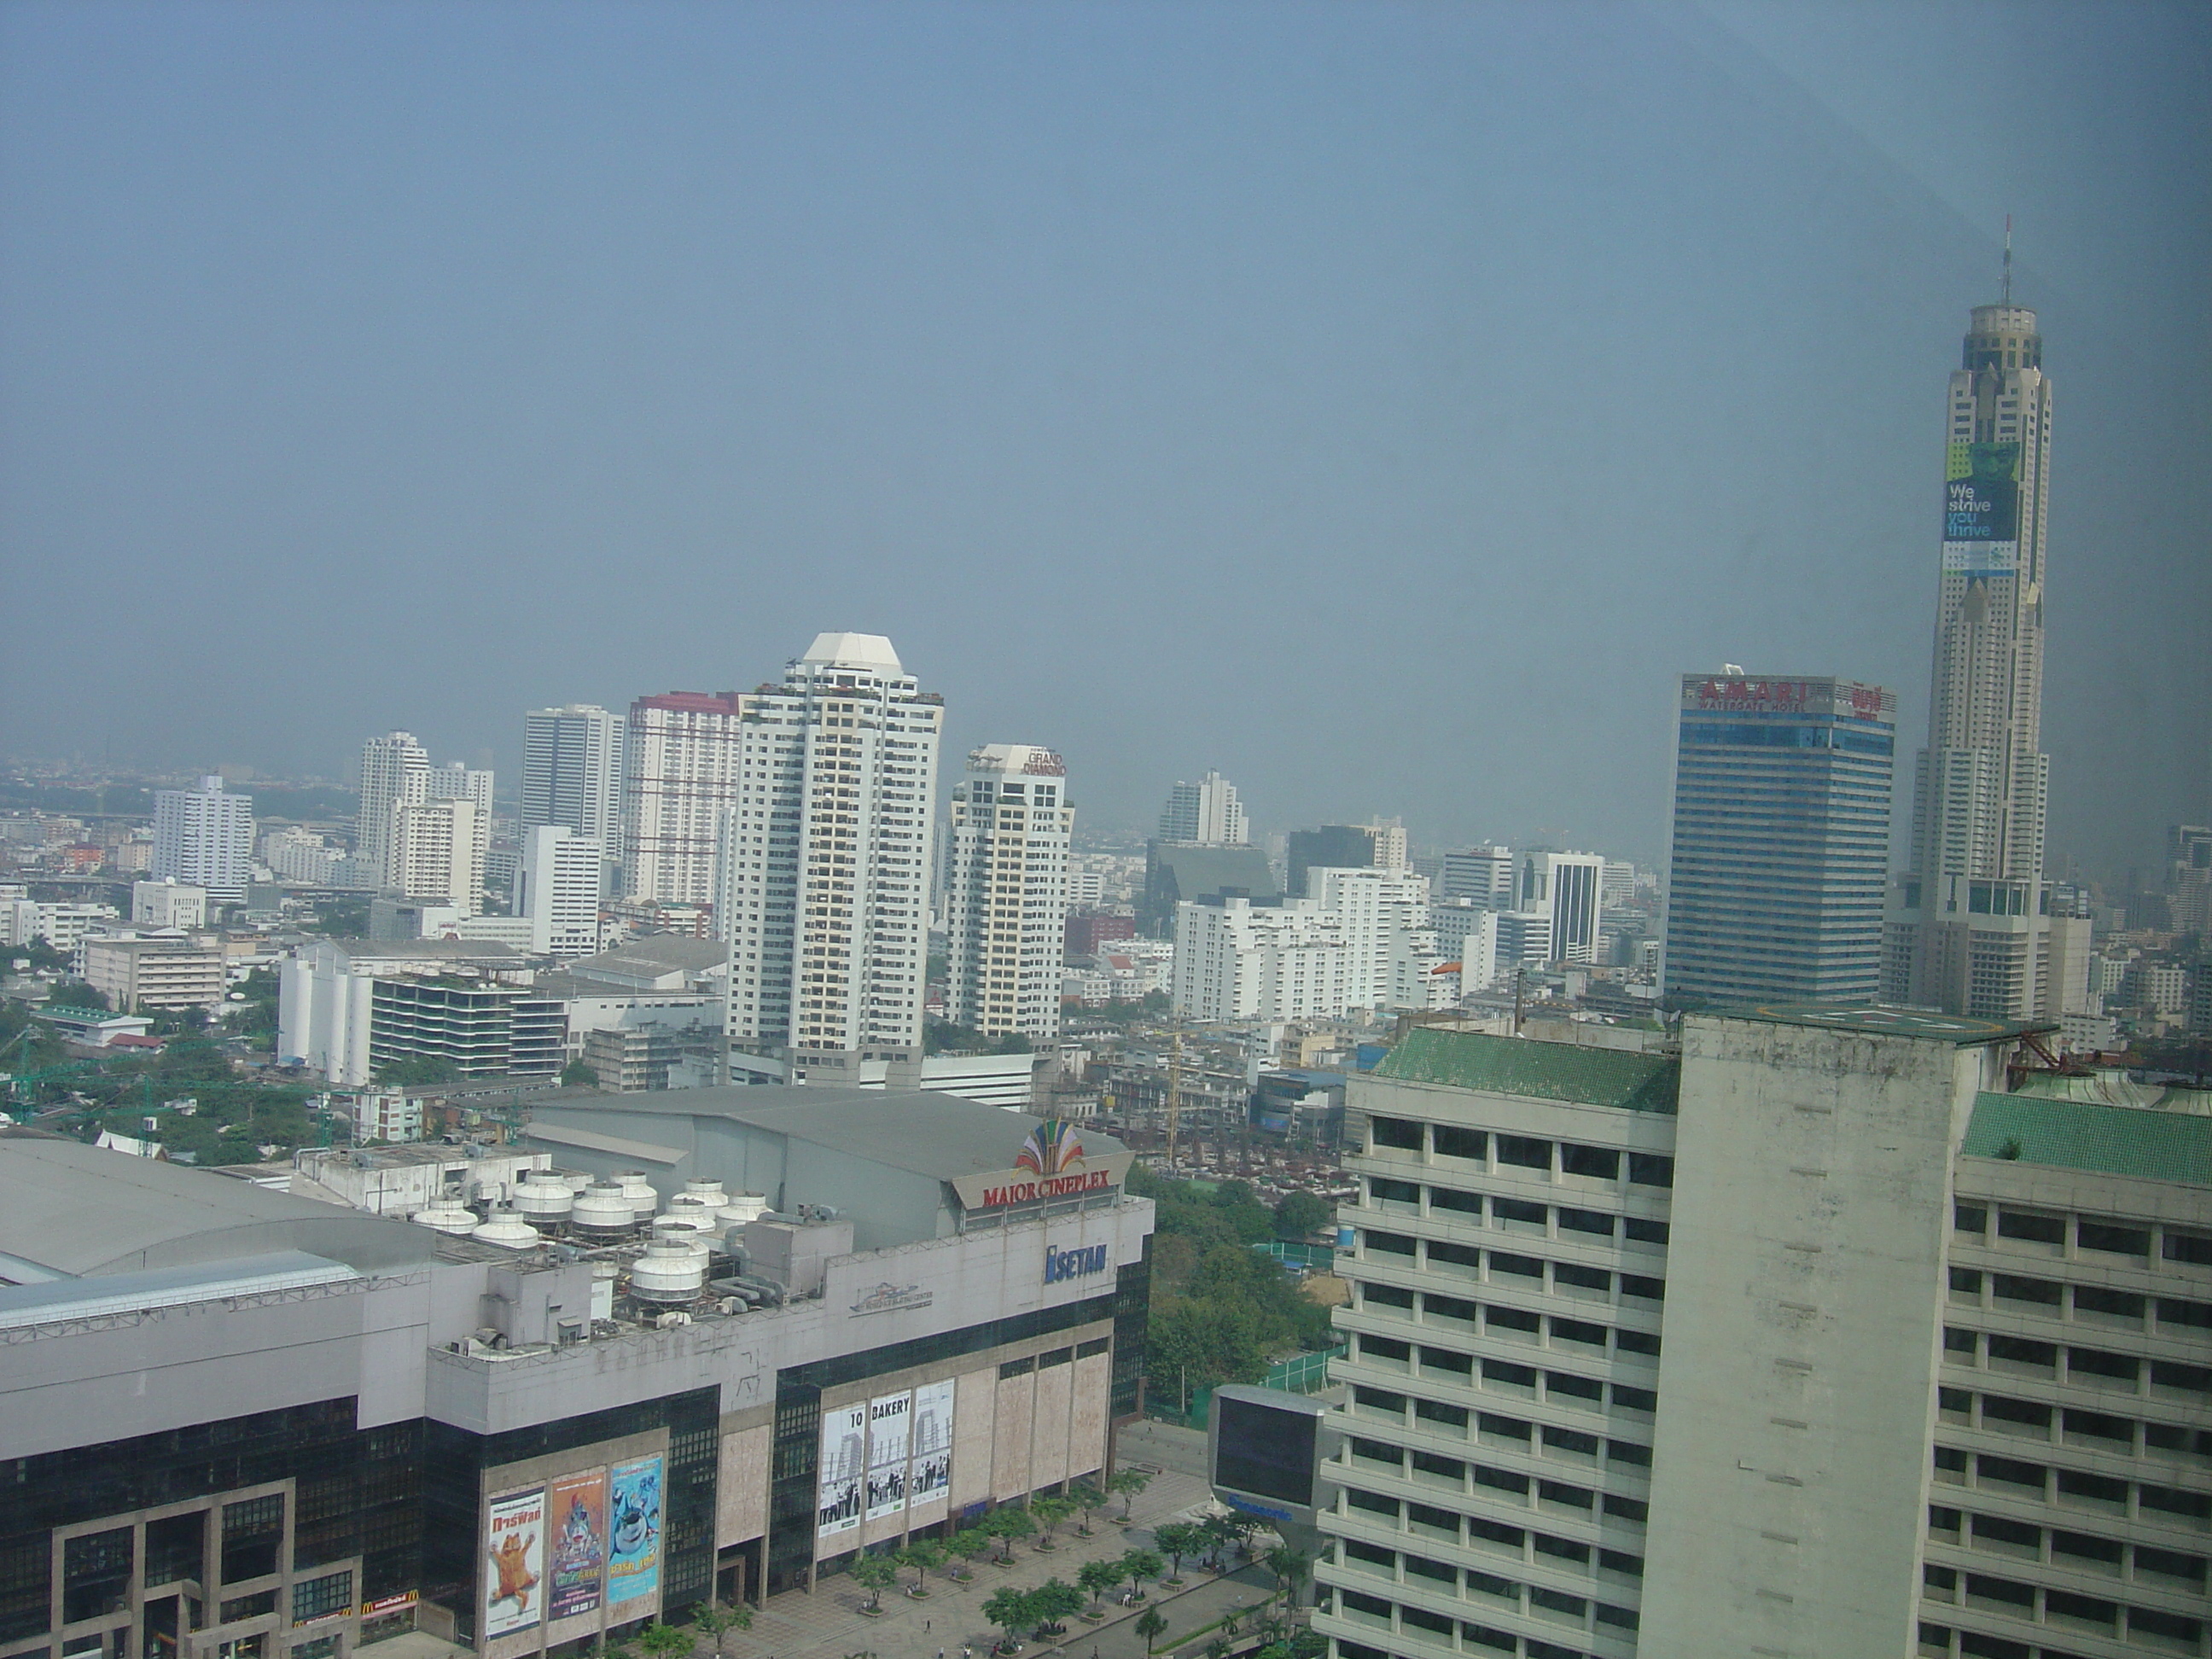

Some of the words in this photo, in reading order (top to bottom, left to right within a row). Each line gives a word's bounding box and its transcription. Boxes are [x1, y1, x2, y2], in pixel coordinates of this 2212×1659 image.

[1950, 484, 1975, 498] We
[1948, 498, 1991, 512] strive
[1948, 512, 1977, 524] you
[1947, 523, 1991, 536] thrive
[1701, 679, 1807, 702] AMARI
[1698, 701, 1764, 712] WATERGATE
[1772, 702, 1806, 713] HOTEL
[1028, 753, 1062, 765] GRAND
[1023, 763, 1067, 777] DIAMOND
[983, 1183, 1036, 1207] MAJOR
[1038, 1170, 1109, 1197] CINEPLEX
[851, 1412, 863, 1428] 10
[871, 1397, 911, 1421] BAKERY
